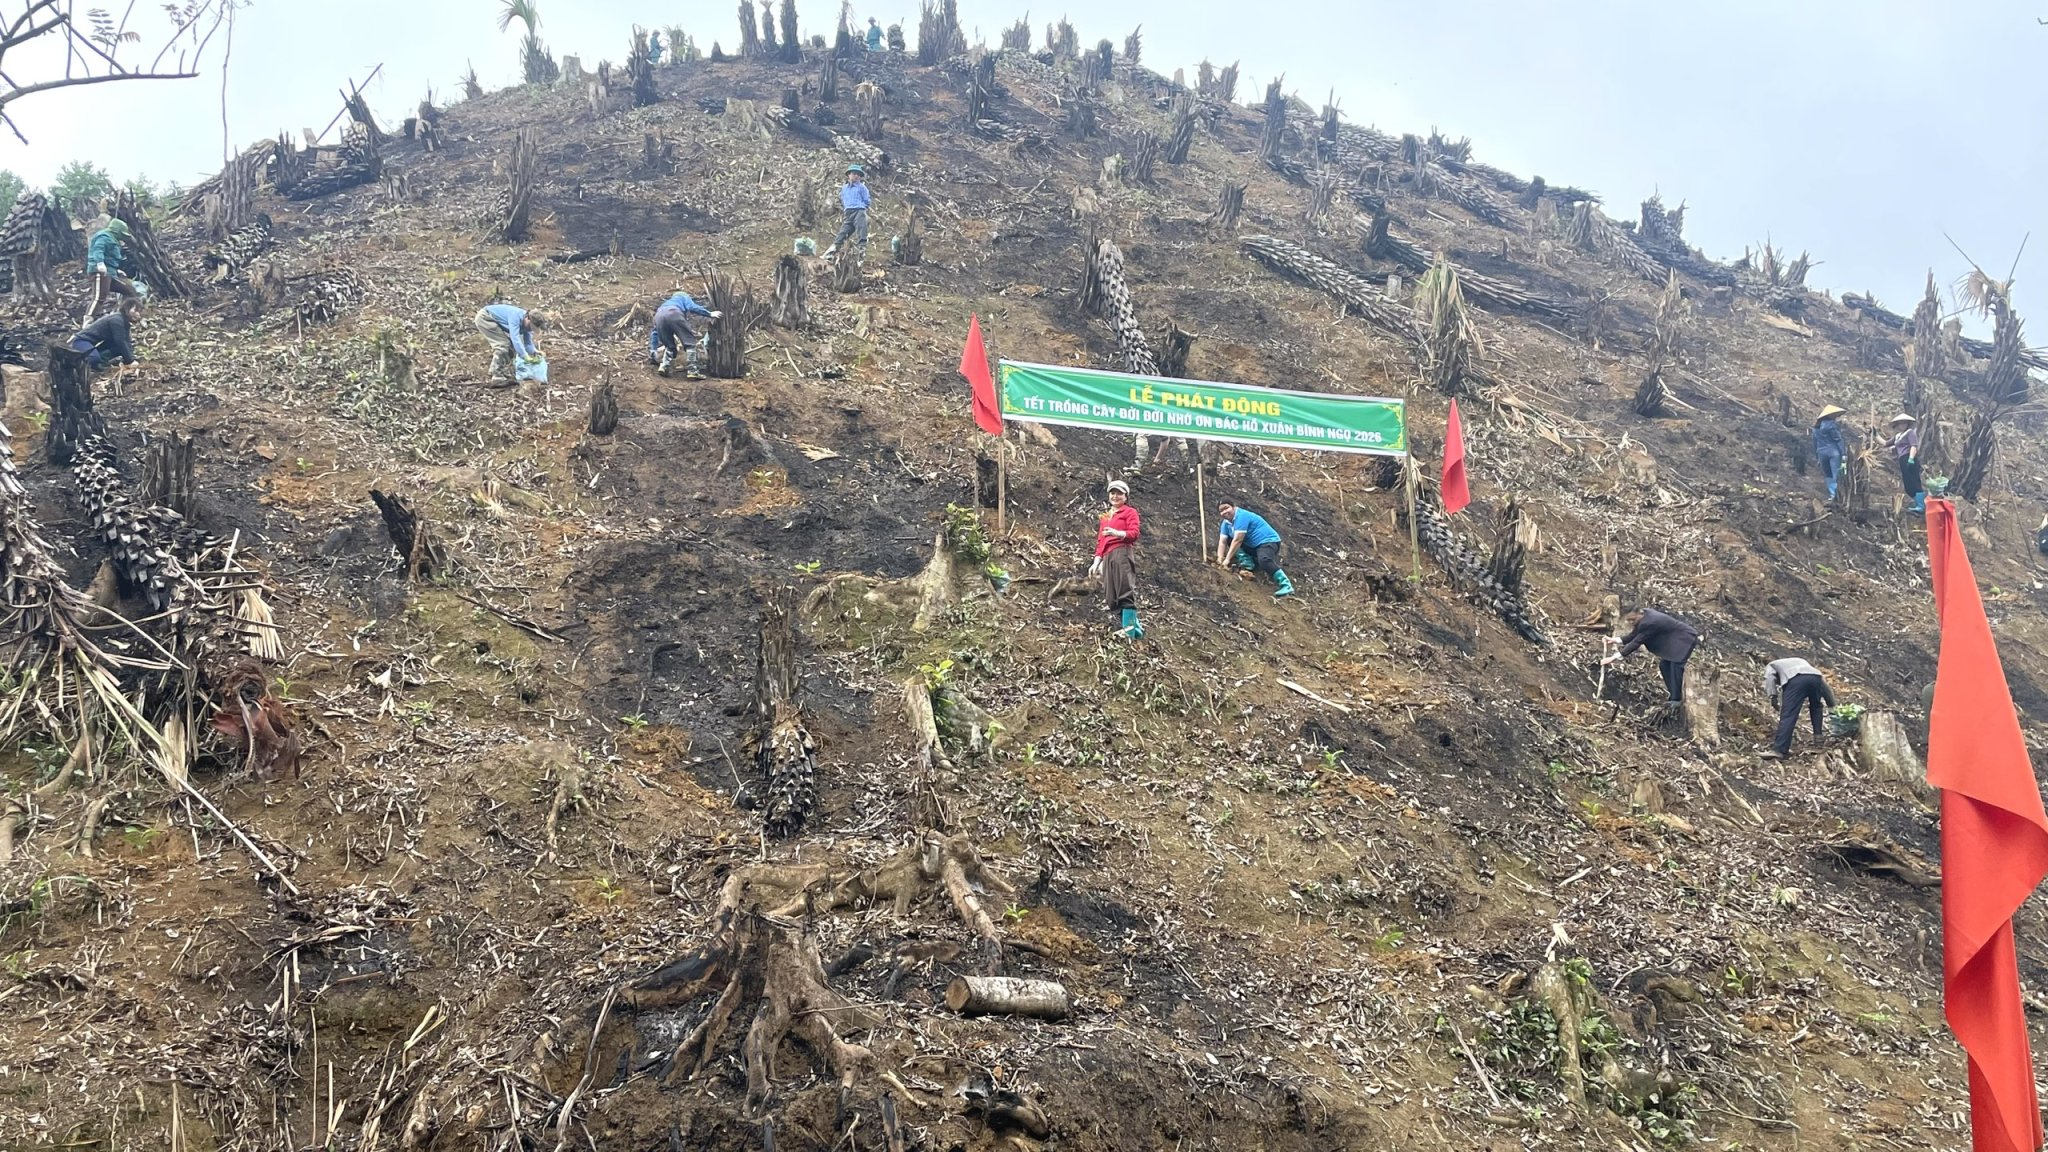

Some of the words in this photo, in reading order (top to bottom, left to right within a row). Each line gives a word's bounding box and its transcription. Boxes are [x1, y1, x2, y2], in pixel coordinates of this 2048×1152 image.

[1023, 395, 1045, 410] TẾT
[1092, 404, 1116, 418] CÂY
[1119, 406, 1140, 421] ĐỜI
[1143, 409, 1164, 424] ĐỜI
[1195, 414, 1213, 428] ƠN
[1215, 416, 1239, 430] BÁC
[1261, 422, 1294, 436] XUÂN
[1296, 423, 1324, 438] BÍNH
[1327, 428, 1352, 443] NGỌ
[1354, 431, 1382, 442] 2026
[1129, 385, 1154, 404] LỄ
[1161, 392, 1216, 410] PHÁT
[1222, 396, 1281, 417] ĐỘNG
